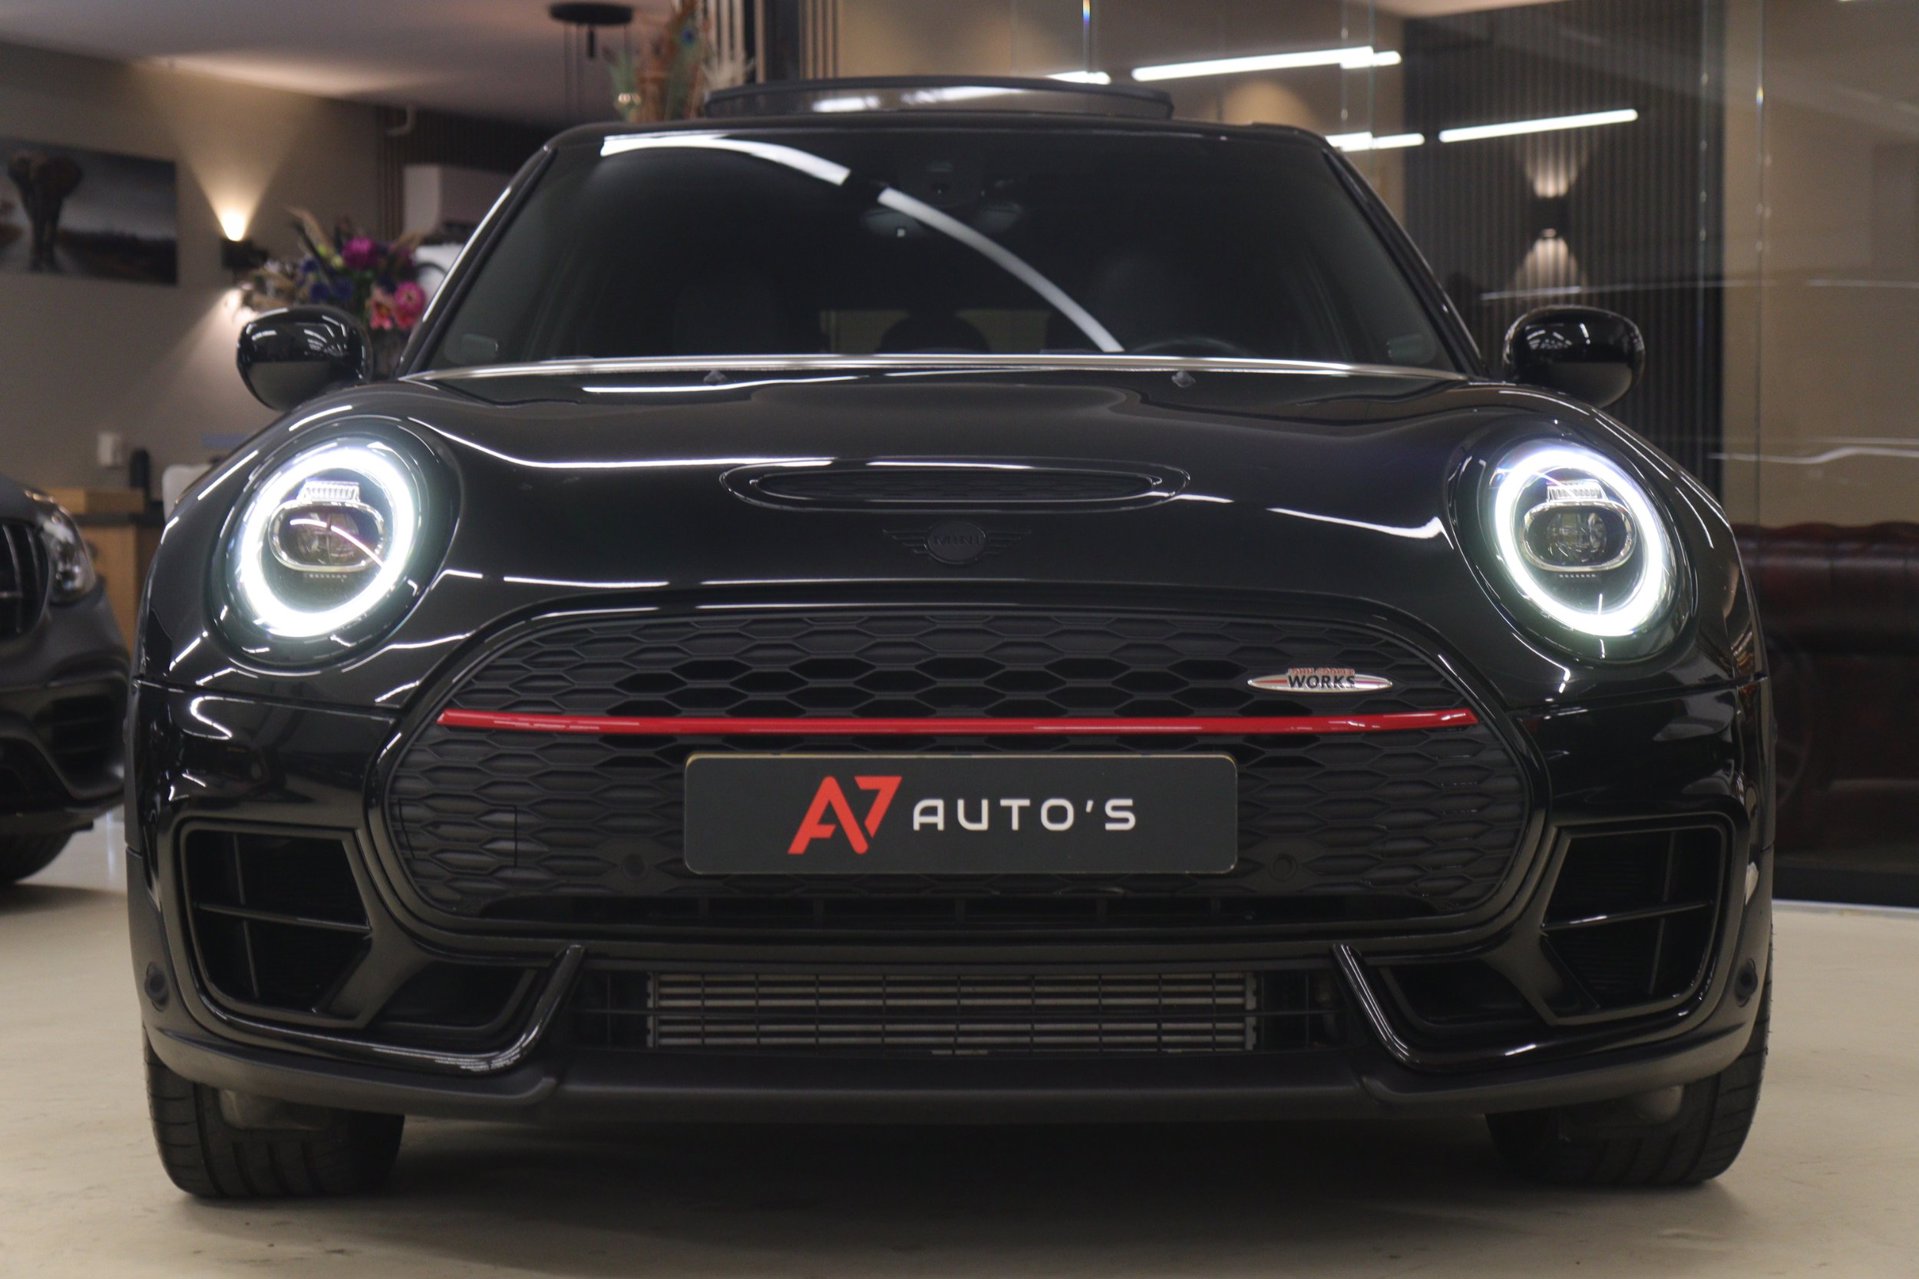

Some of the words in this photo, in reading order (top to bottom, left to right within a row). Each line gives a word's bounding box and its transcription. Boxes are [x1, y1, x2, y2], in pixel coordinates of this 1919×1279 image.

[1288, 675, 1355, 689] WORKS
[788, 776, 902, 854] A7
[912, 798, 1136, 831] AUTO'S
